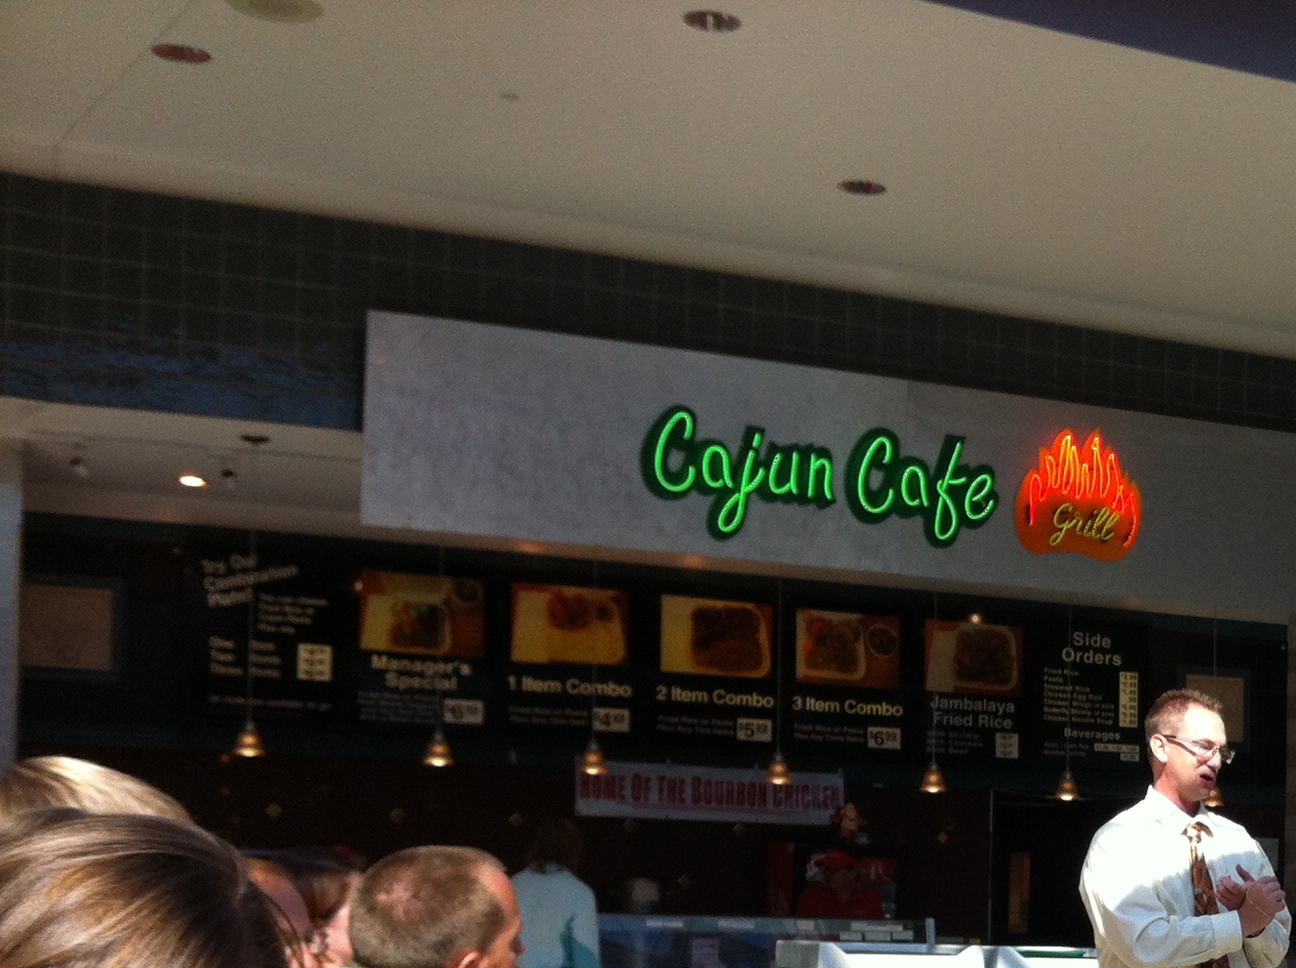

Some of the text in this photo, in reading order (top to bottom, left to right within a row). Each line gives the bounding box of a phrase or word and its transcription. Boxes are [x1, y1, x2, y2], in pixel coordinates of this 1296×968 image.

[648, 408, 998, 544] Cajun Cafe
[1048, 511, 1121, 557] Grill
[1072, 632, 1112, 649] Side
[371, 654, 474, 678] Manager's
[1061, 647, 1121, 666] Orders
[385, 670, 458, 691] Special
[506, 673, 632, 697] 1 Item Combo
[656, 685, 776, 709] 2 Item Combo
[792, 695, 904, 717] 3 Item Combo
[930, 694, 1015, 716] Jambalaya
[932, 711, 1013, 730] Fried Rice
[1064, 727, 1120, 742] Beverages
[630, 773, 651, 803] OF
[657, 775, 686, 804] THE
[691, 776, 767, 808] BOURBON
[772, 783, 841, 811] CHICKEN
